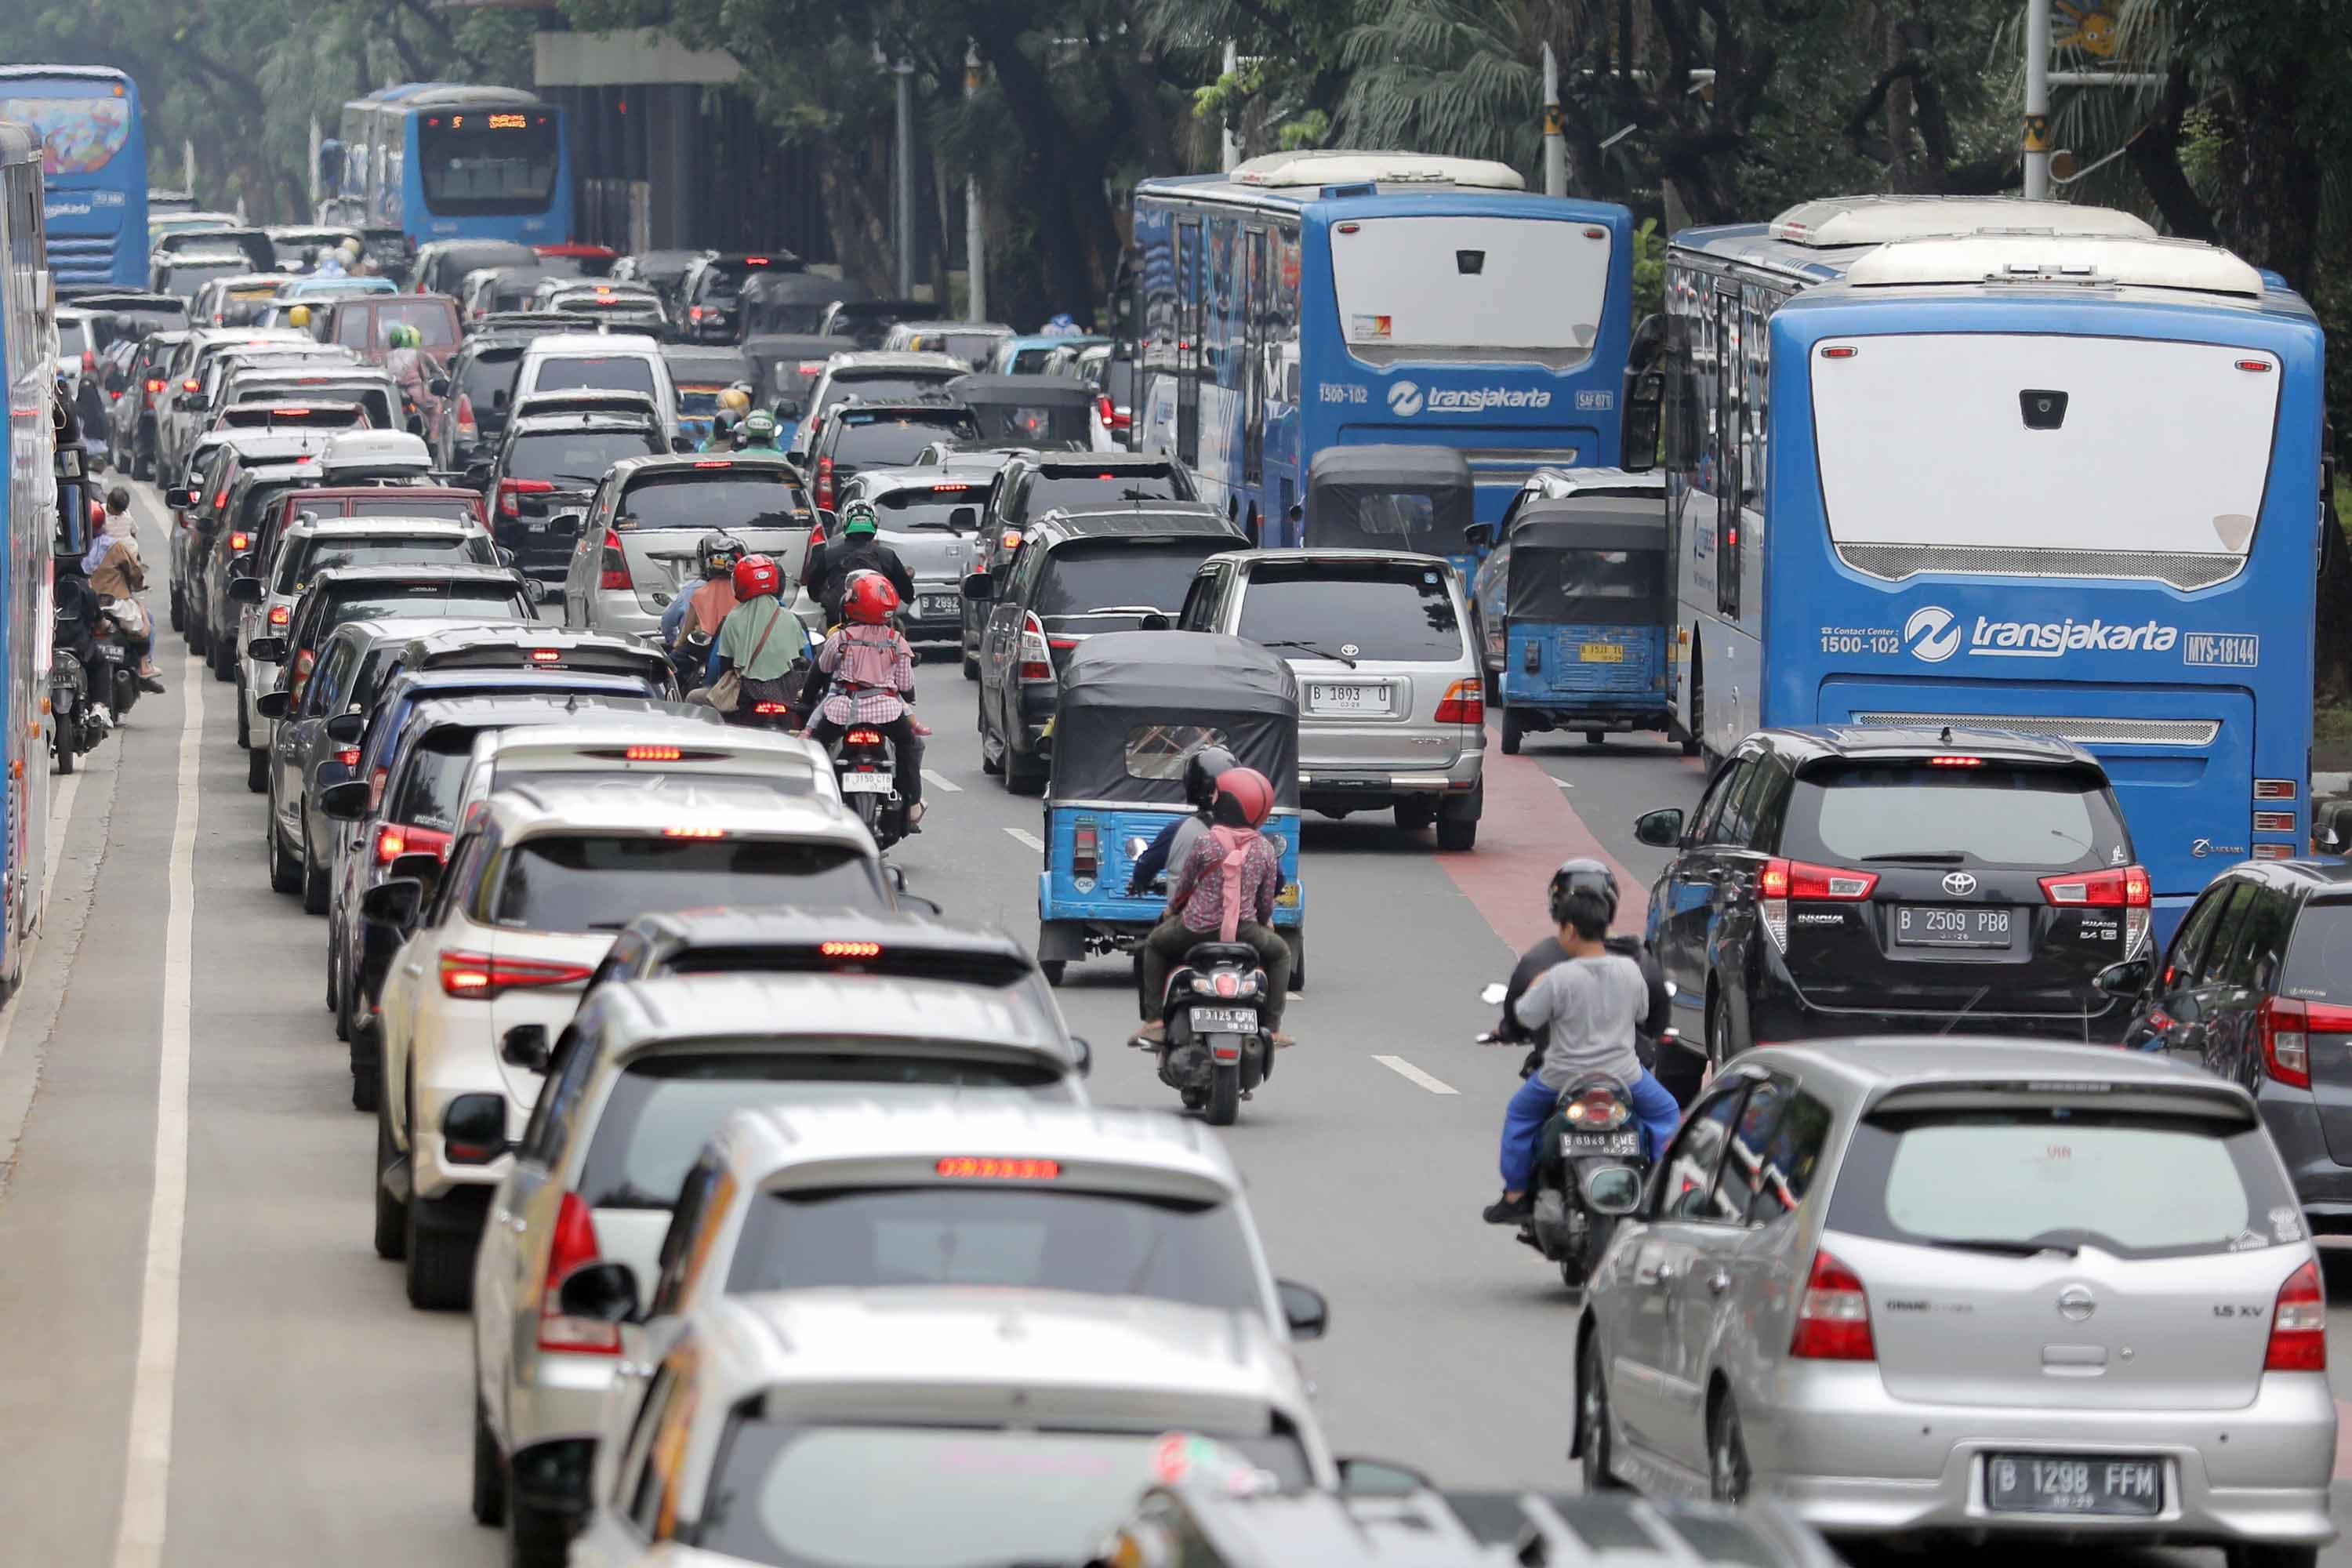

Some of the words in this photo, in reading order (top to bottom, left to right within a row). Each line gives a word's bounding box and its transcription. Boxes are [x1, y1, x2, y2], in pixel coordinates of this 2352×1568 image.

[1427, 386, 1552, 412] transjakarta
[1833, 626, 1864, 636] Contact
[1969, 615, 2178, 657] transjakarta
[1820, 636, 1899, 654] 1500-102
[2187, 636, 2255, 664] MYS-18144
[1313, 686, 1321, 700] B
[1330, 687, 1360, 700] 1893
[1078, 880, 1093, 888] CNG
[1900, 910, 1911, 930] B
[1926, 911, 1965, 931] 2509
[2239, 1305, 2265, 1317] XV
[1999, 1459, 2016, 1491] B
[2031, 1461, 2089, 1494] 1298
[2105, 1463, 2154, 1496] FFM
